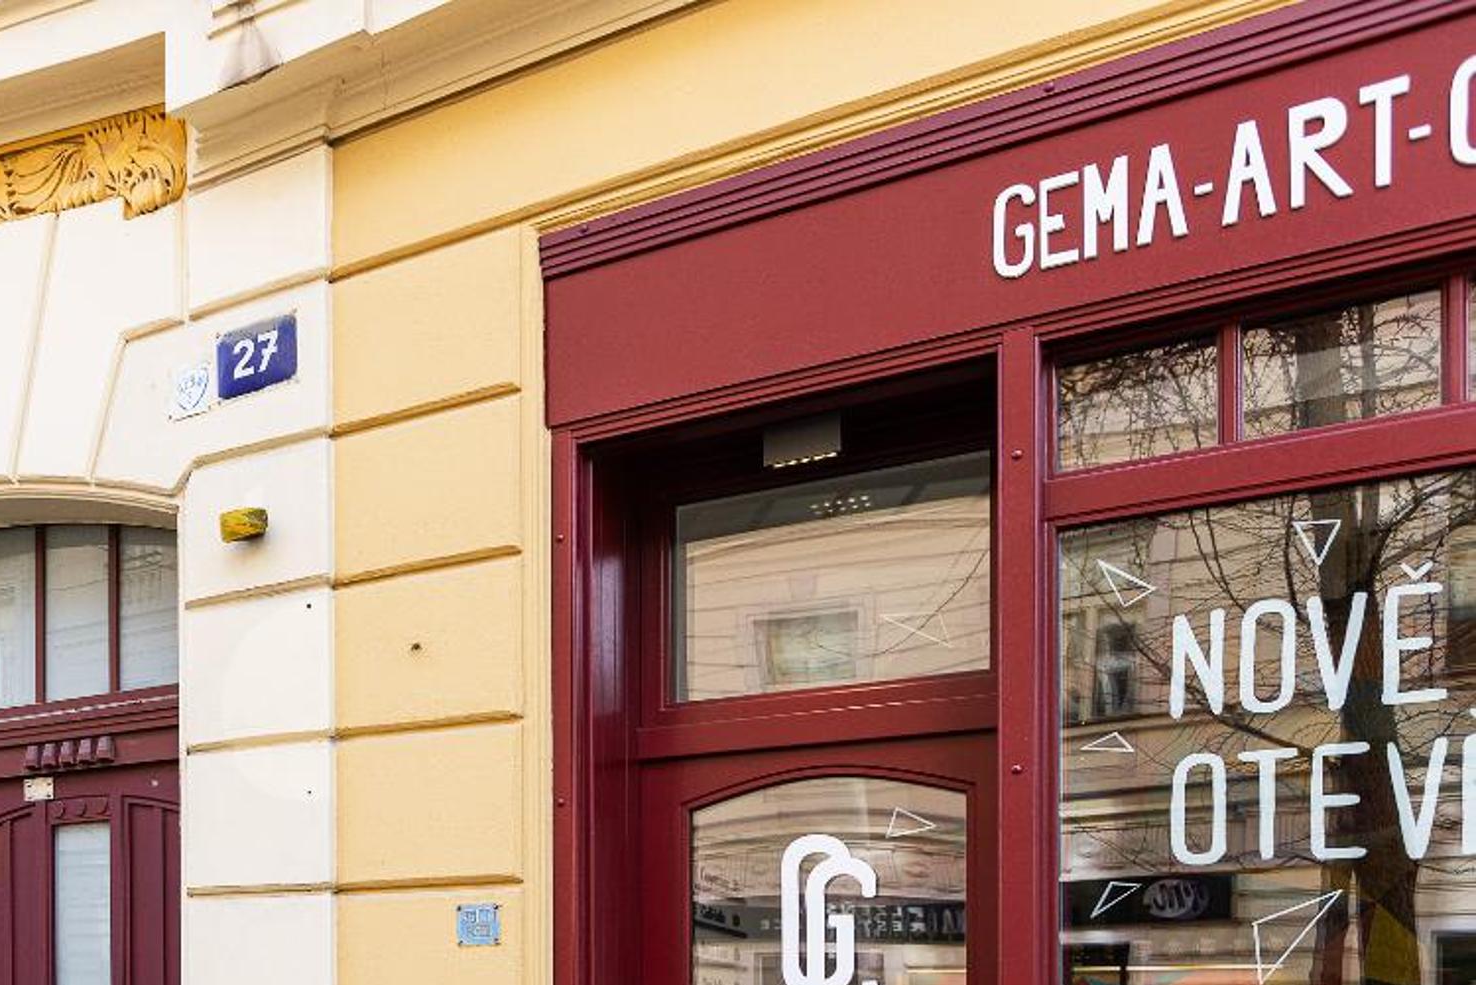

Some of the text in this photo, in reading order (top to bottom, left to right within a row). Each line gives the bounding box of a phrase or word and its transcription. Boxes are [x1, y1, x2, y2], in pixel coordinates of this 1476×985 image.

[233, 330, 278, 379] 27
[1169, 560, 1447, 720] NOVĚ
[1170, 708, 1476, 866] OTEV
